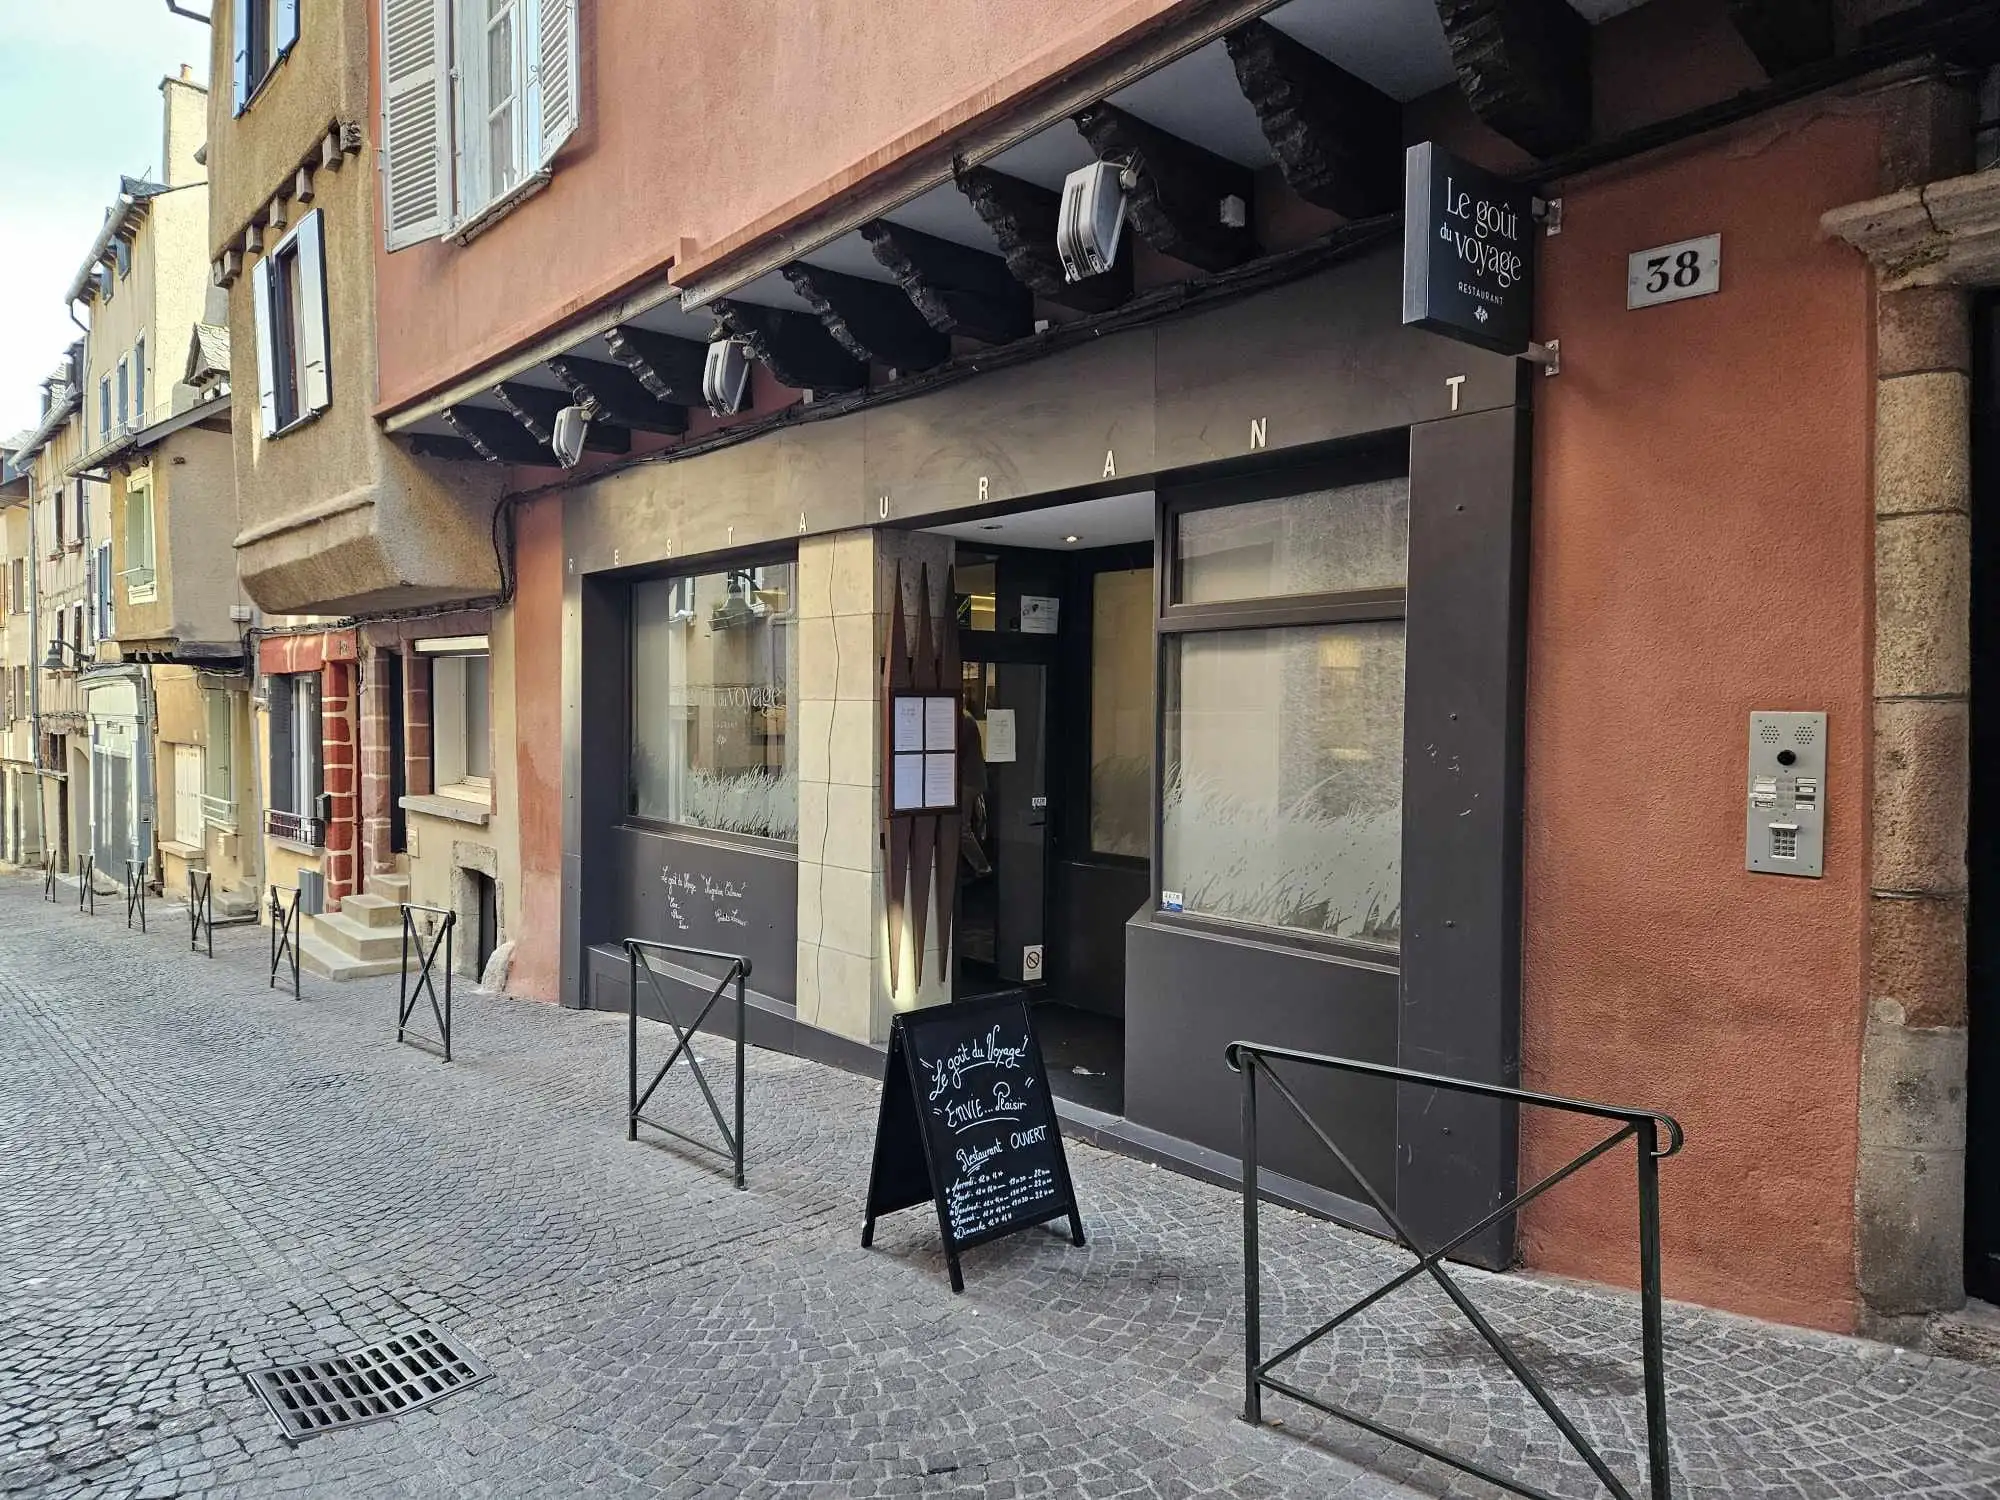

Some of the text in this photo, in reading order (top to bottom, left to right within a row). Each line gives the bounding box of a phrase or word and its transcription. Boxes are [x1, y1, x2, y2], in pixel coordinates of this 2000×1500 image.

[1447, 176, 1518, 241] Le goût
[1440, 221, 1521, 288] du voyage
[1646, 250, 1701, 293] 38
[1458, 281, 1504, 305] RESTAURANT
[929, 1059, 948, 1101] Le
[947, 1042, 970, 1089] goût
[972, 1039, 985, 1058] du
[956, 1124, 1047, 1172] Restaurant OUVERT
